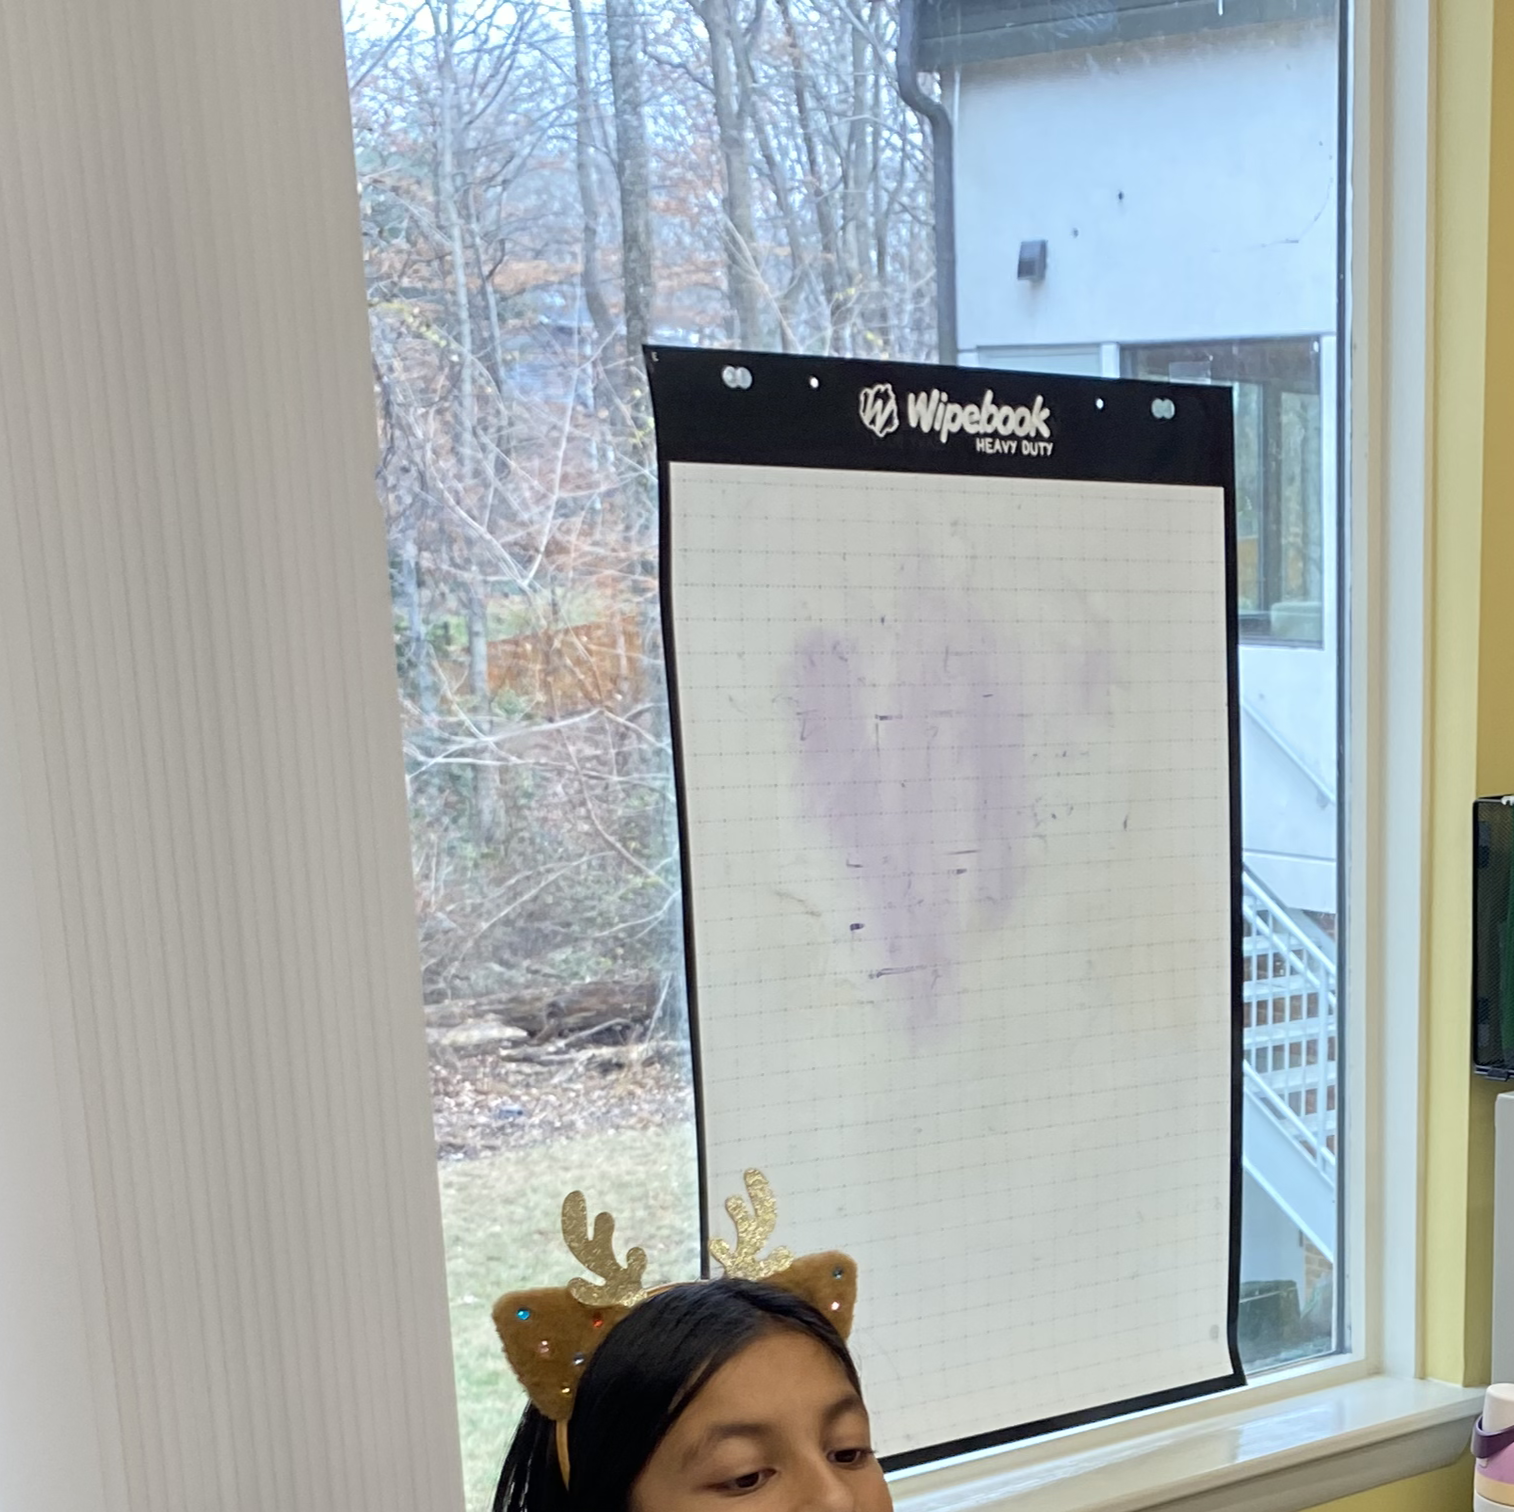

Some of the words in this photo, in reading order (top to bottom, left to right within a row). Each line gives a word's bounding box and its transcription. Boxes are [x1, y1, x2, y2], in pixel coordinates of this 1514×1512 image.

[907, 388, 1052, 442] Wipebook
[976, 437, 1017, 456] HEAVY
[1021, 439, 1054, 457] DUTY
